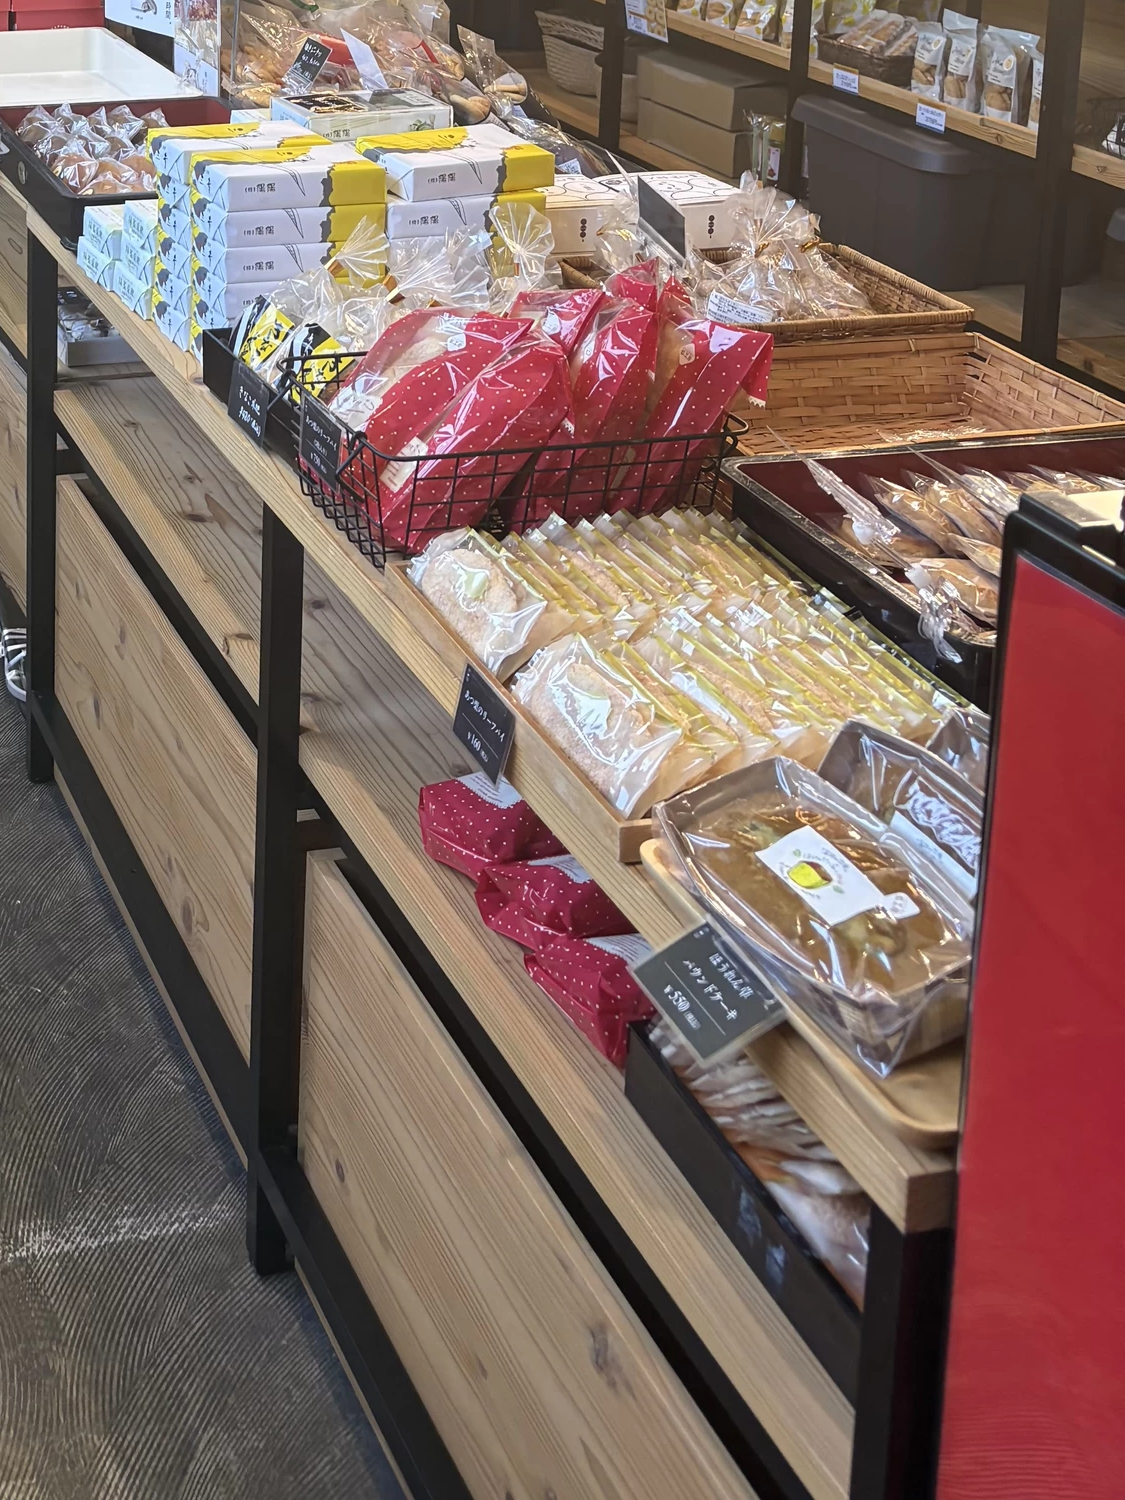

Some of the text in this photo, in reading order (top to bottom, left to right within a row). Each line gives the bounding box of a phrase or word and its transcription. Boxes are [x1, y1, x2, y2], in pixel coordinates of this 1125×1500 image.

[663, 984, 691, 1013] ¥550
[682, 960, 739, 1021] パウンドケーキ
[708, 952, 755, 1000] ほうれん草
